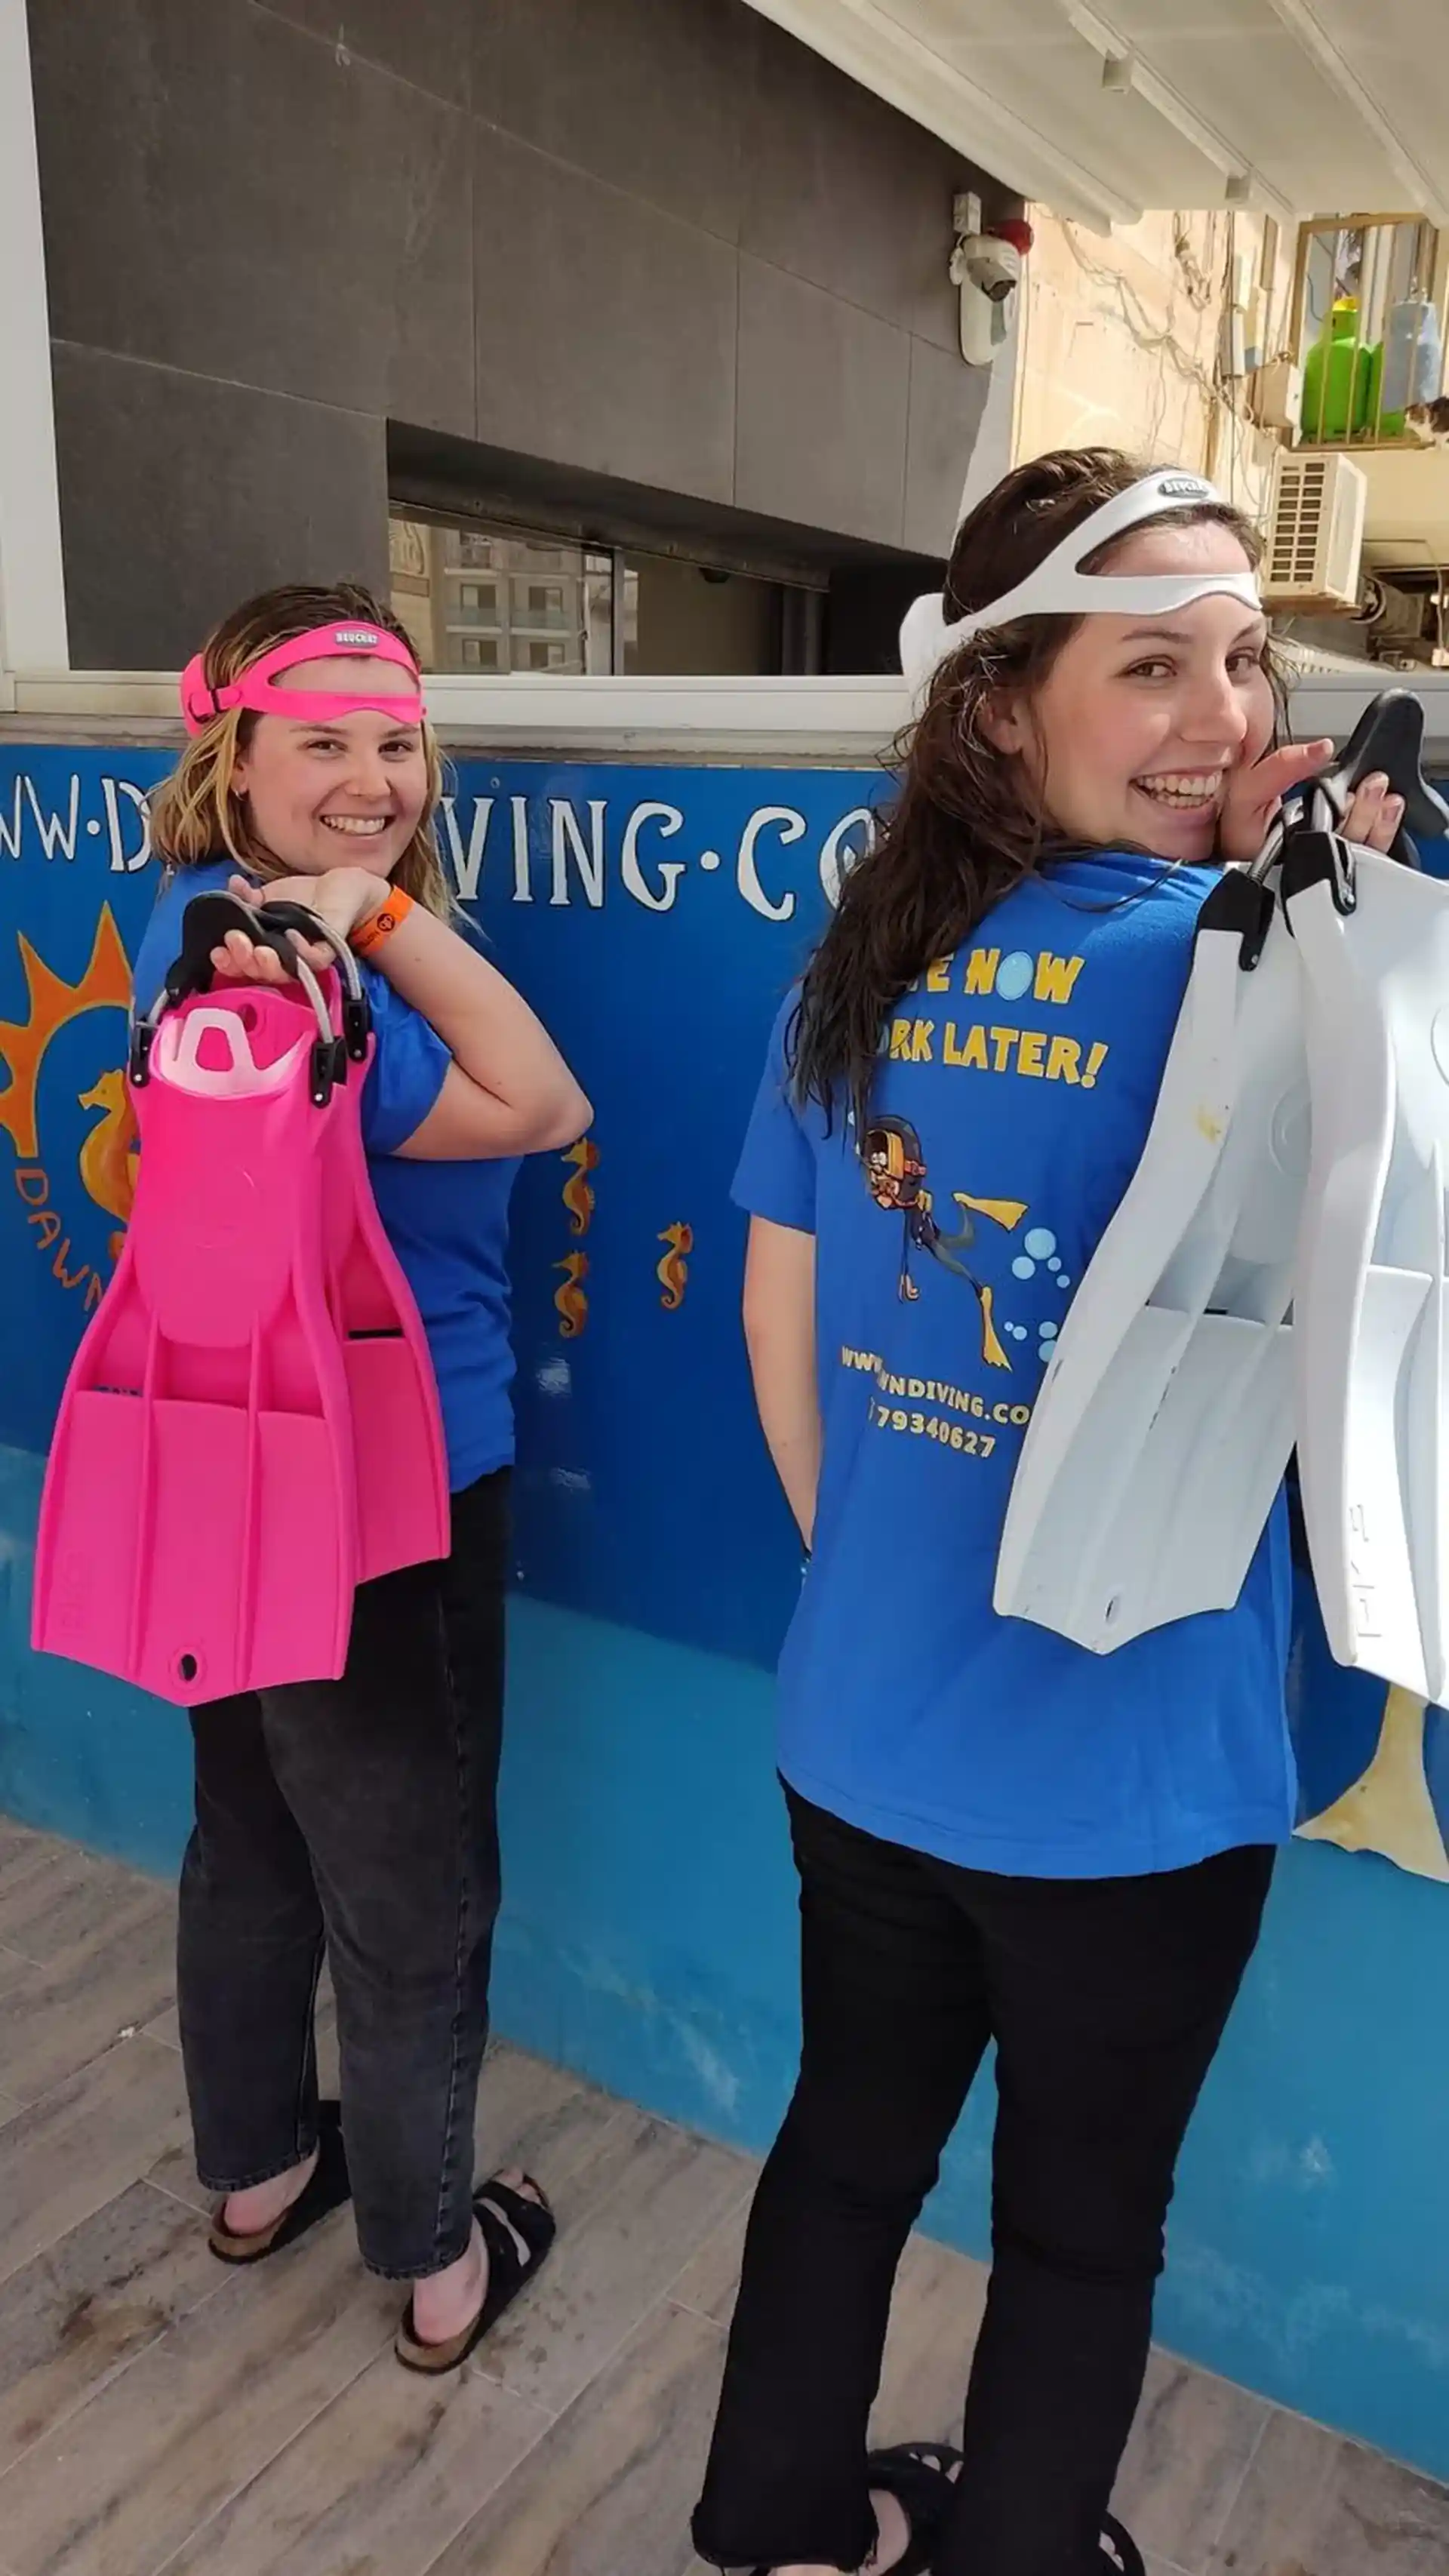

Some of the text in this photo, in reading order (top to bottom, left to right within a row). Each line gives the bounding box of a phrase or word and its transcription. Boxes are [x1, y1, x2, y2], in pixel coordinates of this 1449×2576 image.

[964, 948, 1085, 1004] NOW
[880, 1019, 1109, 1088] RK LATER!
